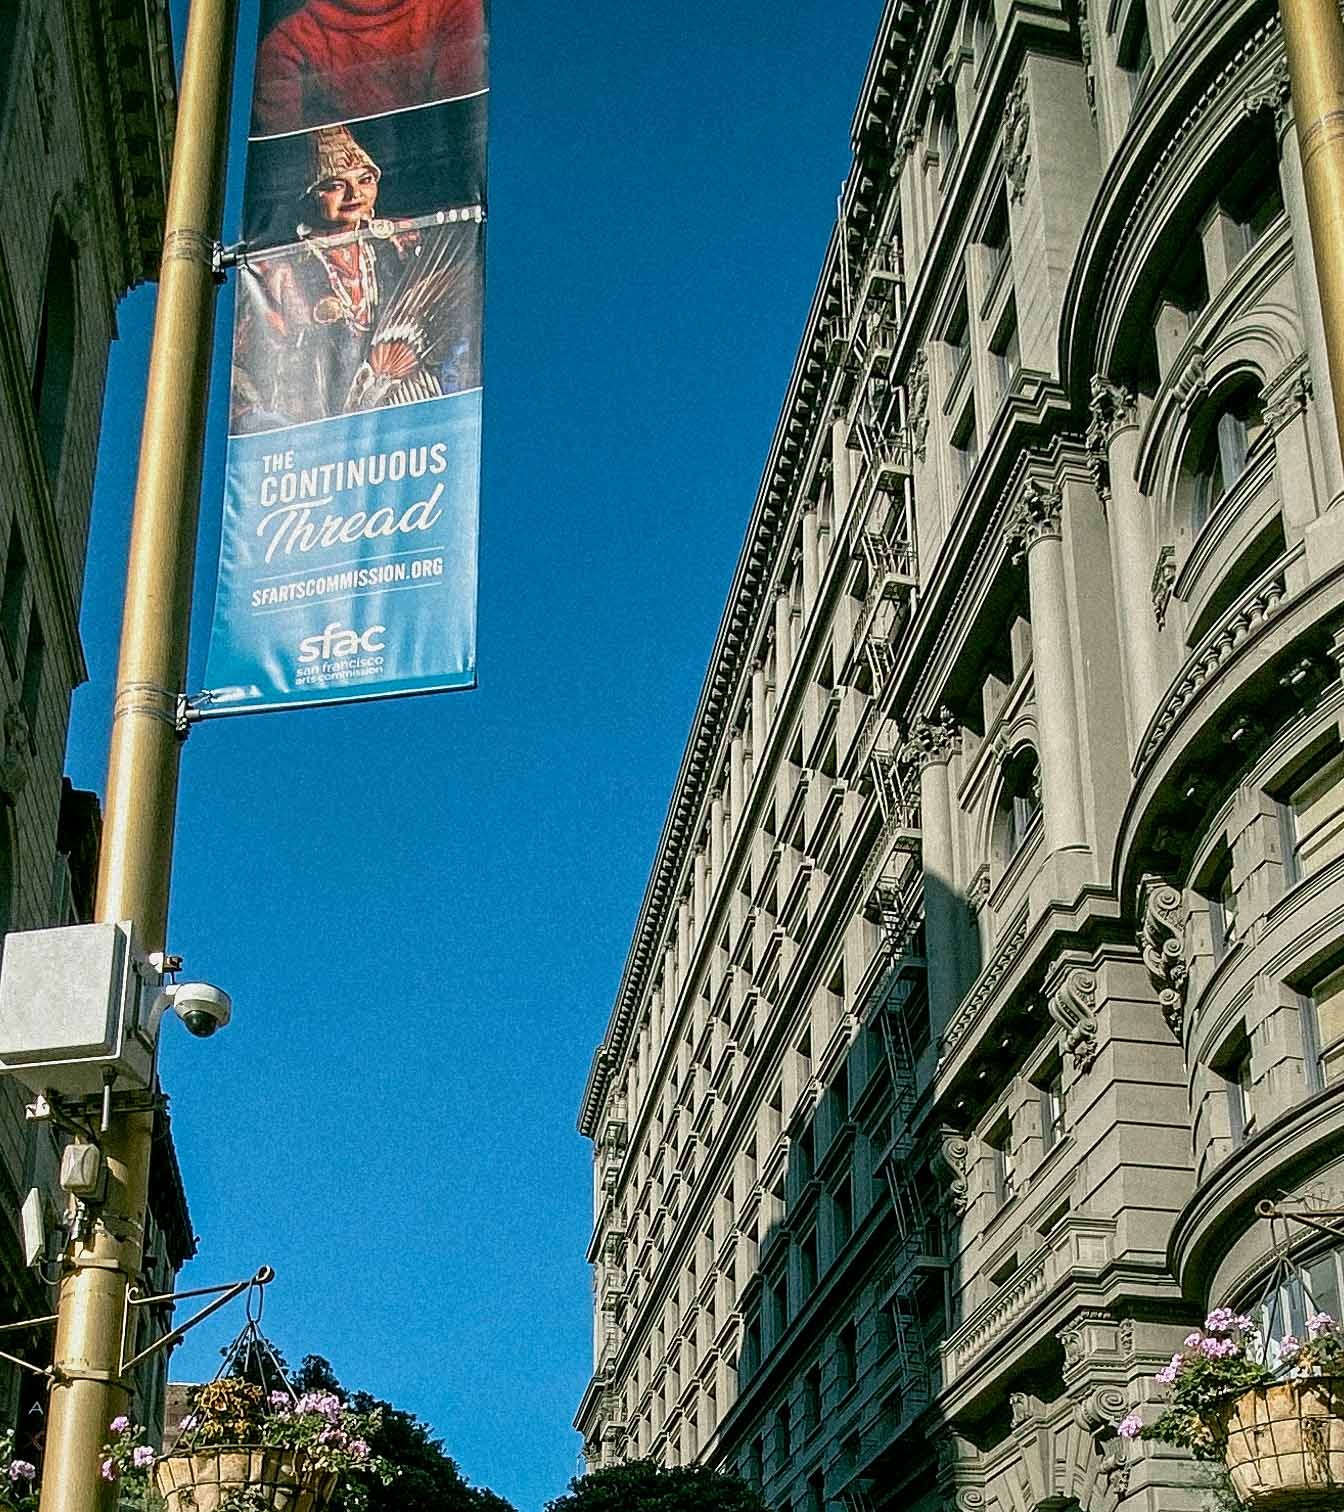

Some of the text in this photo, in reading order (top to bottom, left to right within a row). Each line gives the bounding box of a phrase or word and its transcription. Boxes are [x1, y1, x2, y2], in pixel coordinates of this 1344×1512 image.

[259, 442, 448, 507] CONTINUOUS
[261, 449, 295, 475] THE
[256, 483, 446, 564] Thread
[250, 557, 444, 608] SFARTSCOMMISSION.ORG
[297, 622, 386, 663] sfac
[322, 656, 385, 674] francisco
